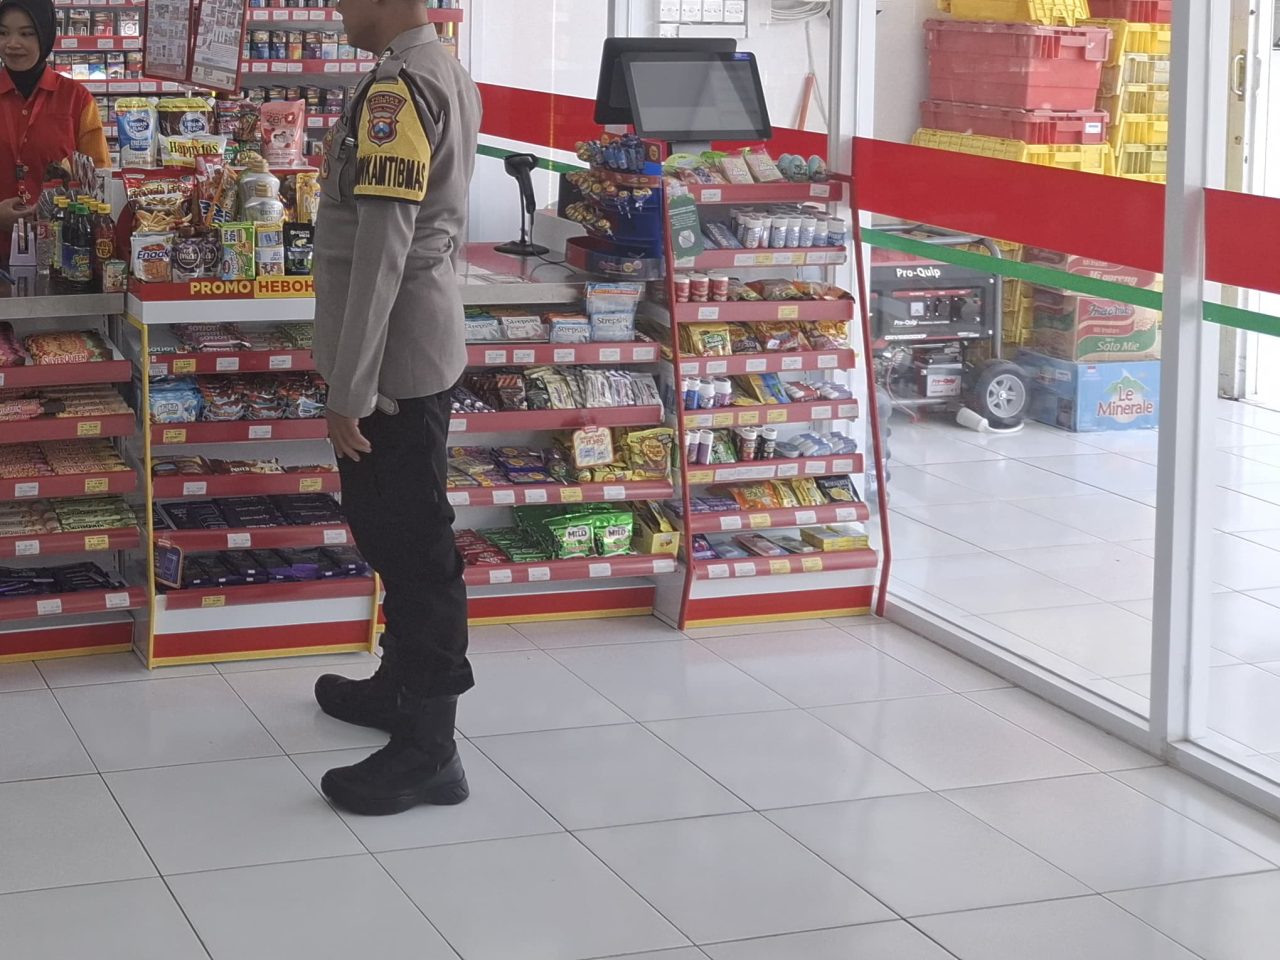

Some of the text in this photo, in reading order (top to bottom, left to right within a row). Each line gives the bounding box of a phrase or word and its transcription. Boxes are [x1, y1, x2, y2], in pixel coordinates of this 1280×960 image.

[896, 266, 941, 278] Pro-Quip
[190, 280, 315, 295] PROMO HEBOH
[1097, 341, 1139, 351] Soto Mie
[1119, 385, 1134, 401] Le
[1097, 400, 1153, 417] Minerale
[567, 529, 587, 539] MILO
[608, 528, 627, 537] MILO
